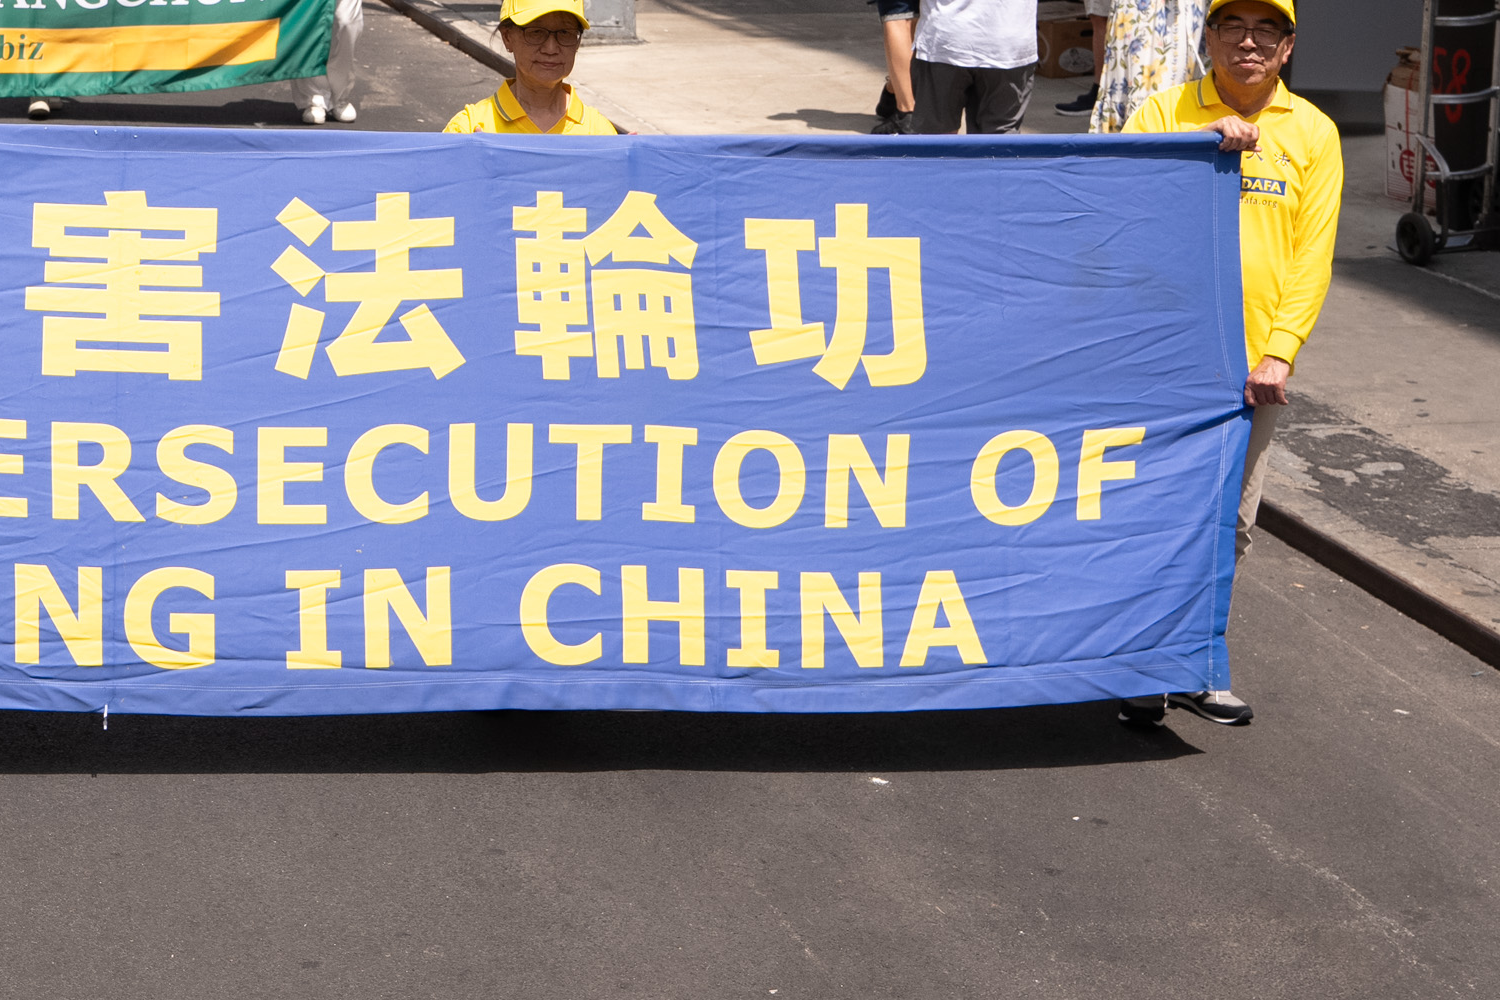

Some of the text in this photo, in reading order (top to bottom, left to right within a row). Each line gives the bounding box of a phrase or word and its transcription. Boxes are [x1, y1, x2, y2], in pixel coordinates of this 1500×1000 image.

[1240, 179, 1283, 195] DAFA
[1240, 195, 1279, 209] dafa.org
[968, 423, 1147, 527] OF
[285, 565, 454, 671] IN
[518, 560, 989, 670] CHINA
